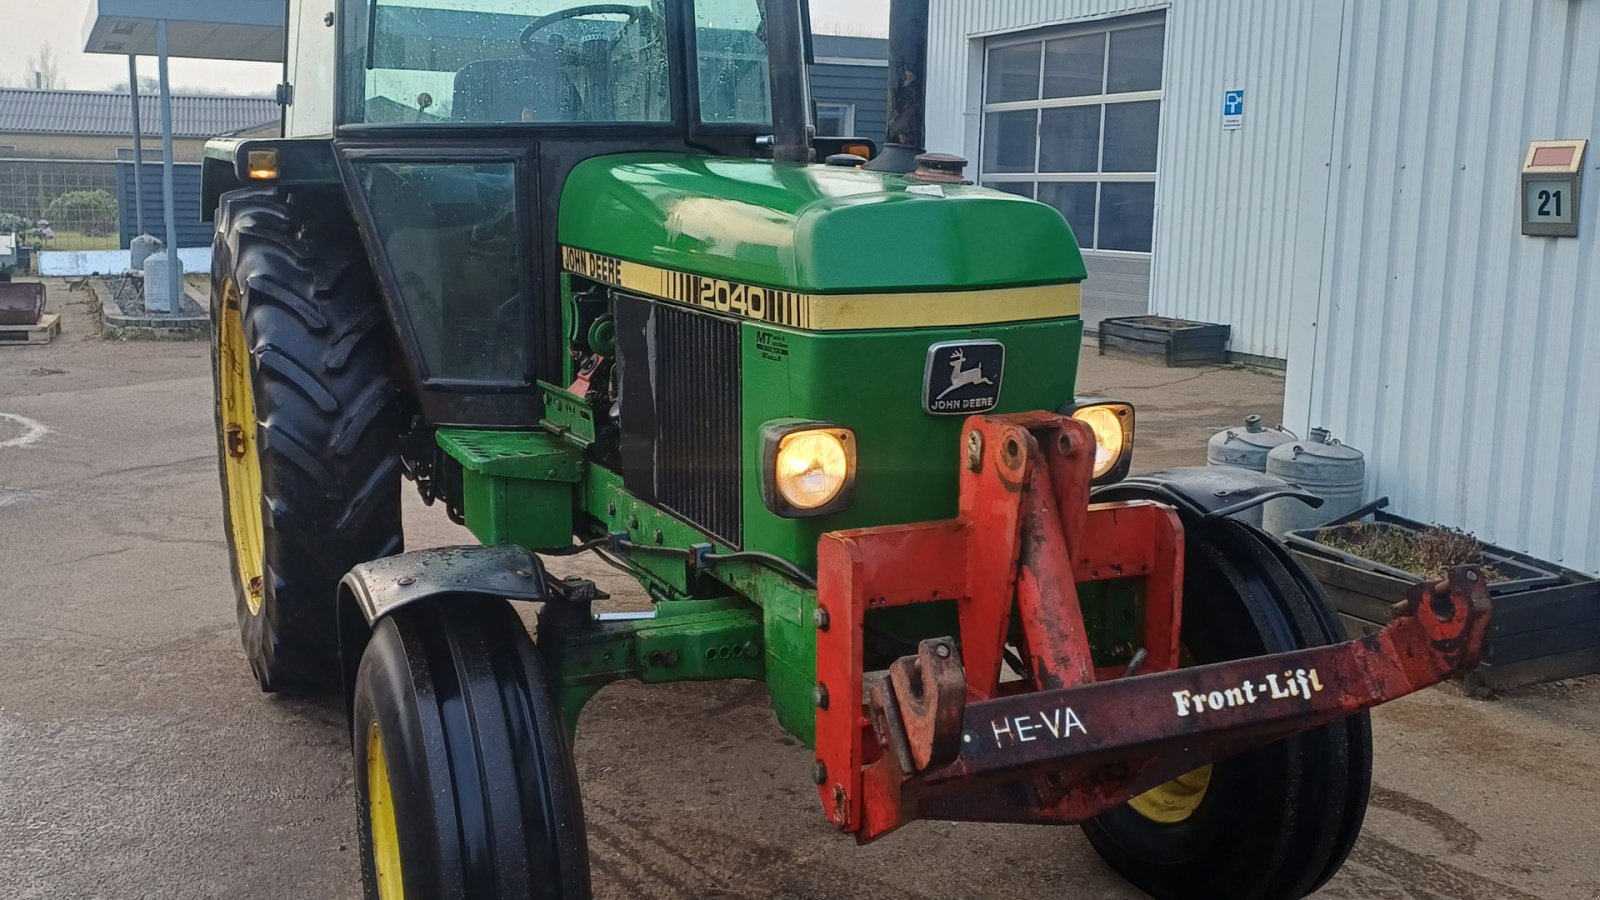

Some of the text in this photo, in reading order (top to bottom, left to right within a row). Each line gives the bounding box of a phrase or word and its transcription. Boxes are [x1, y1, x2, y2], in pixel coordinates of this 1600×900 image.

[1537, 189, 1562, 217] 21
[563, 247, 622, 286] JOHN DEERE
[700, 276, 765, 320] 2040
[931, 397, 994, 410] JOHN DEERE
[991, 668, 1324, 749] HE-VA Front-Lift
